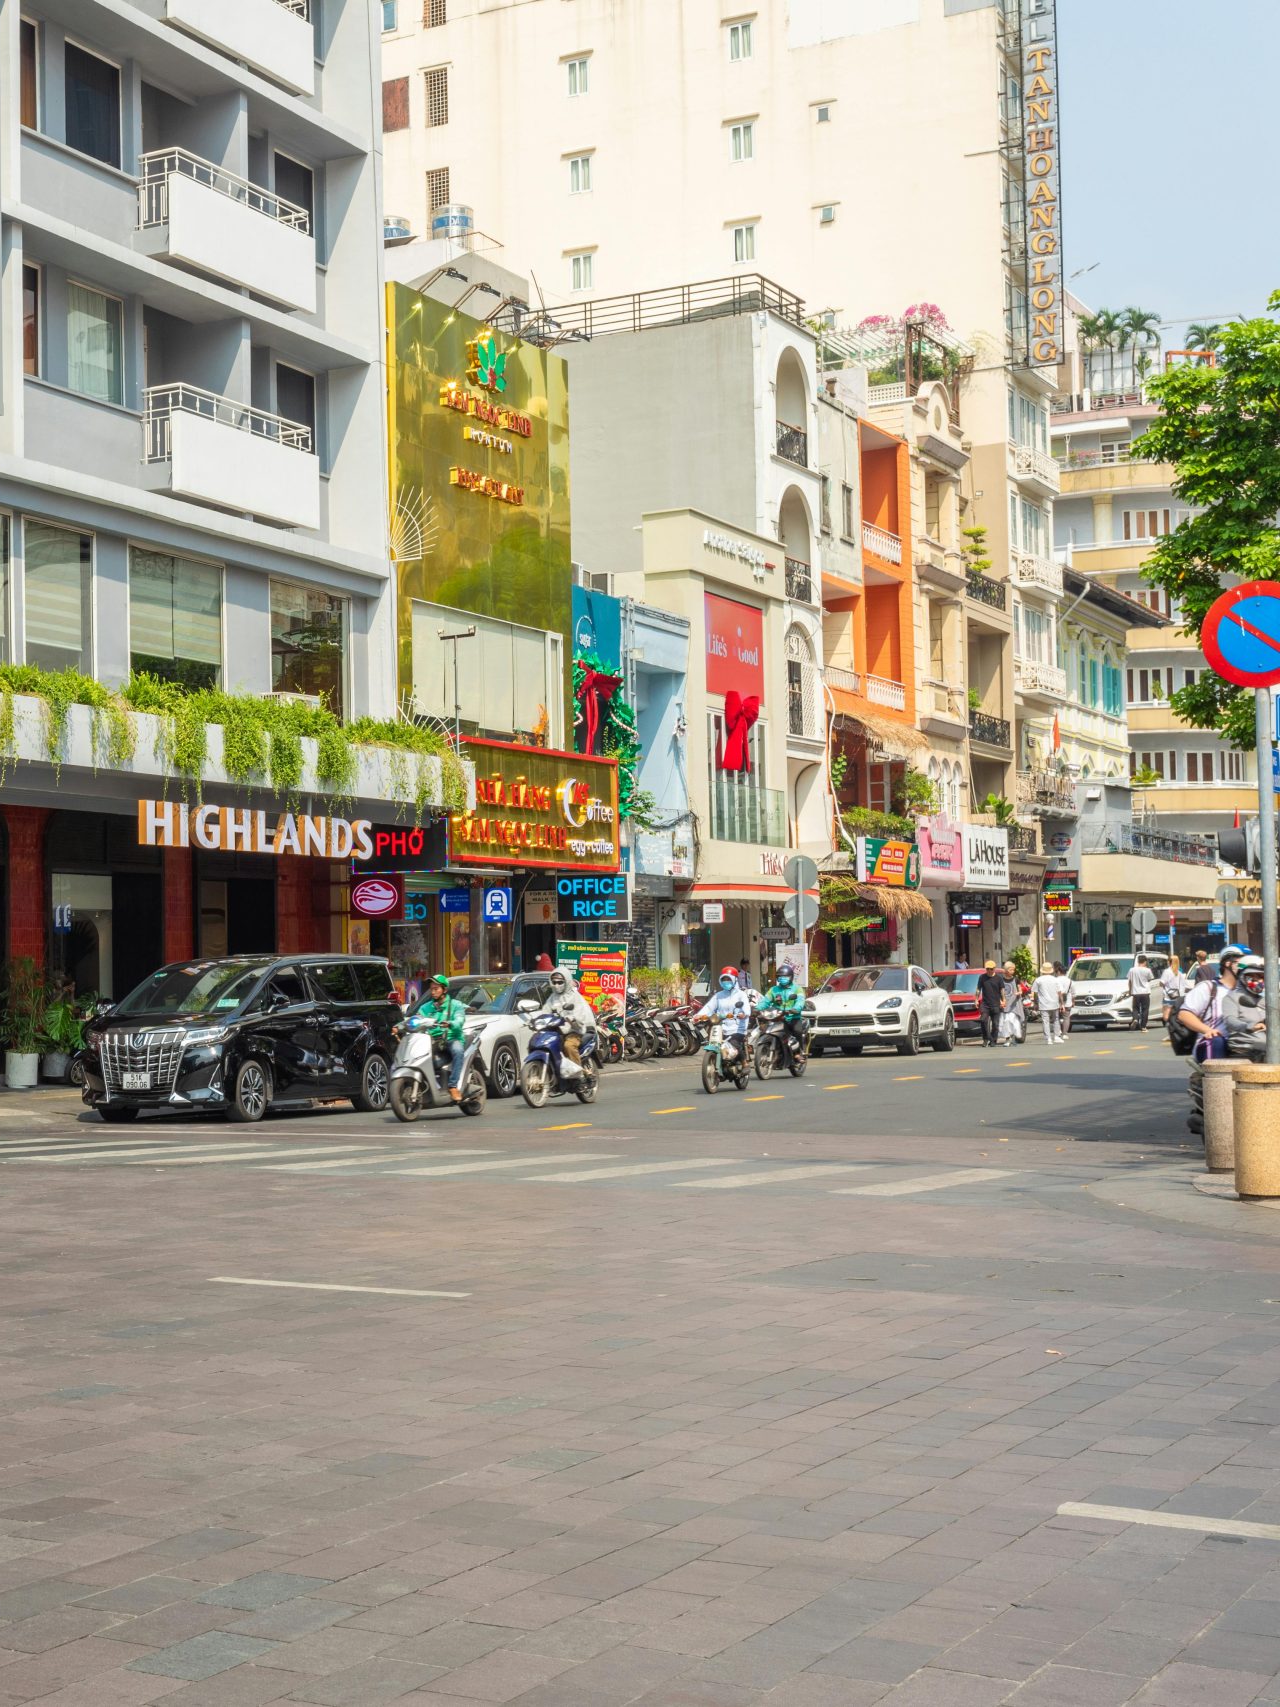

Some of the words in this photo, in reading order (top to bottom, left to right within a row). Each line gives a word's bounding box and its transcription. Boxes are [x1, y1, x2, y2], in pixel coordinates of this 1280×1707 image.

[139, 799, 373, 860] HIGHLANDS
[558, 877, 625, 896] OFFICE
[573, 900, 617, 917] RICE
[601, 973, 624, 989] 68K
